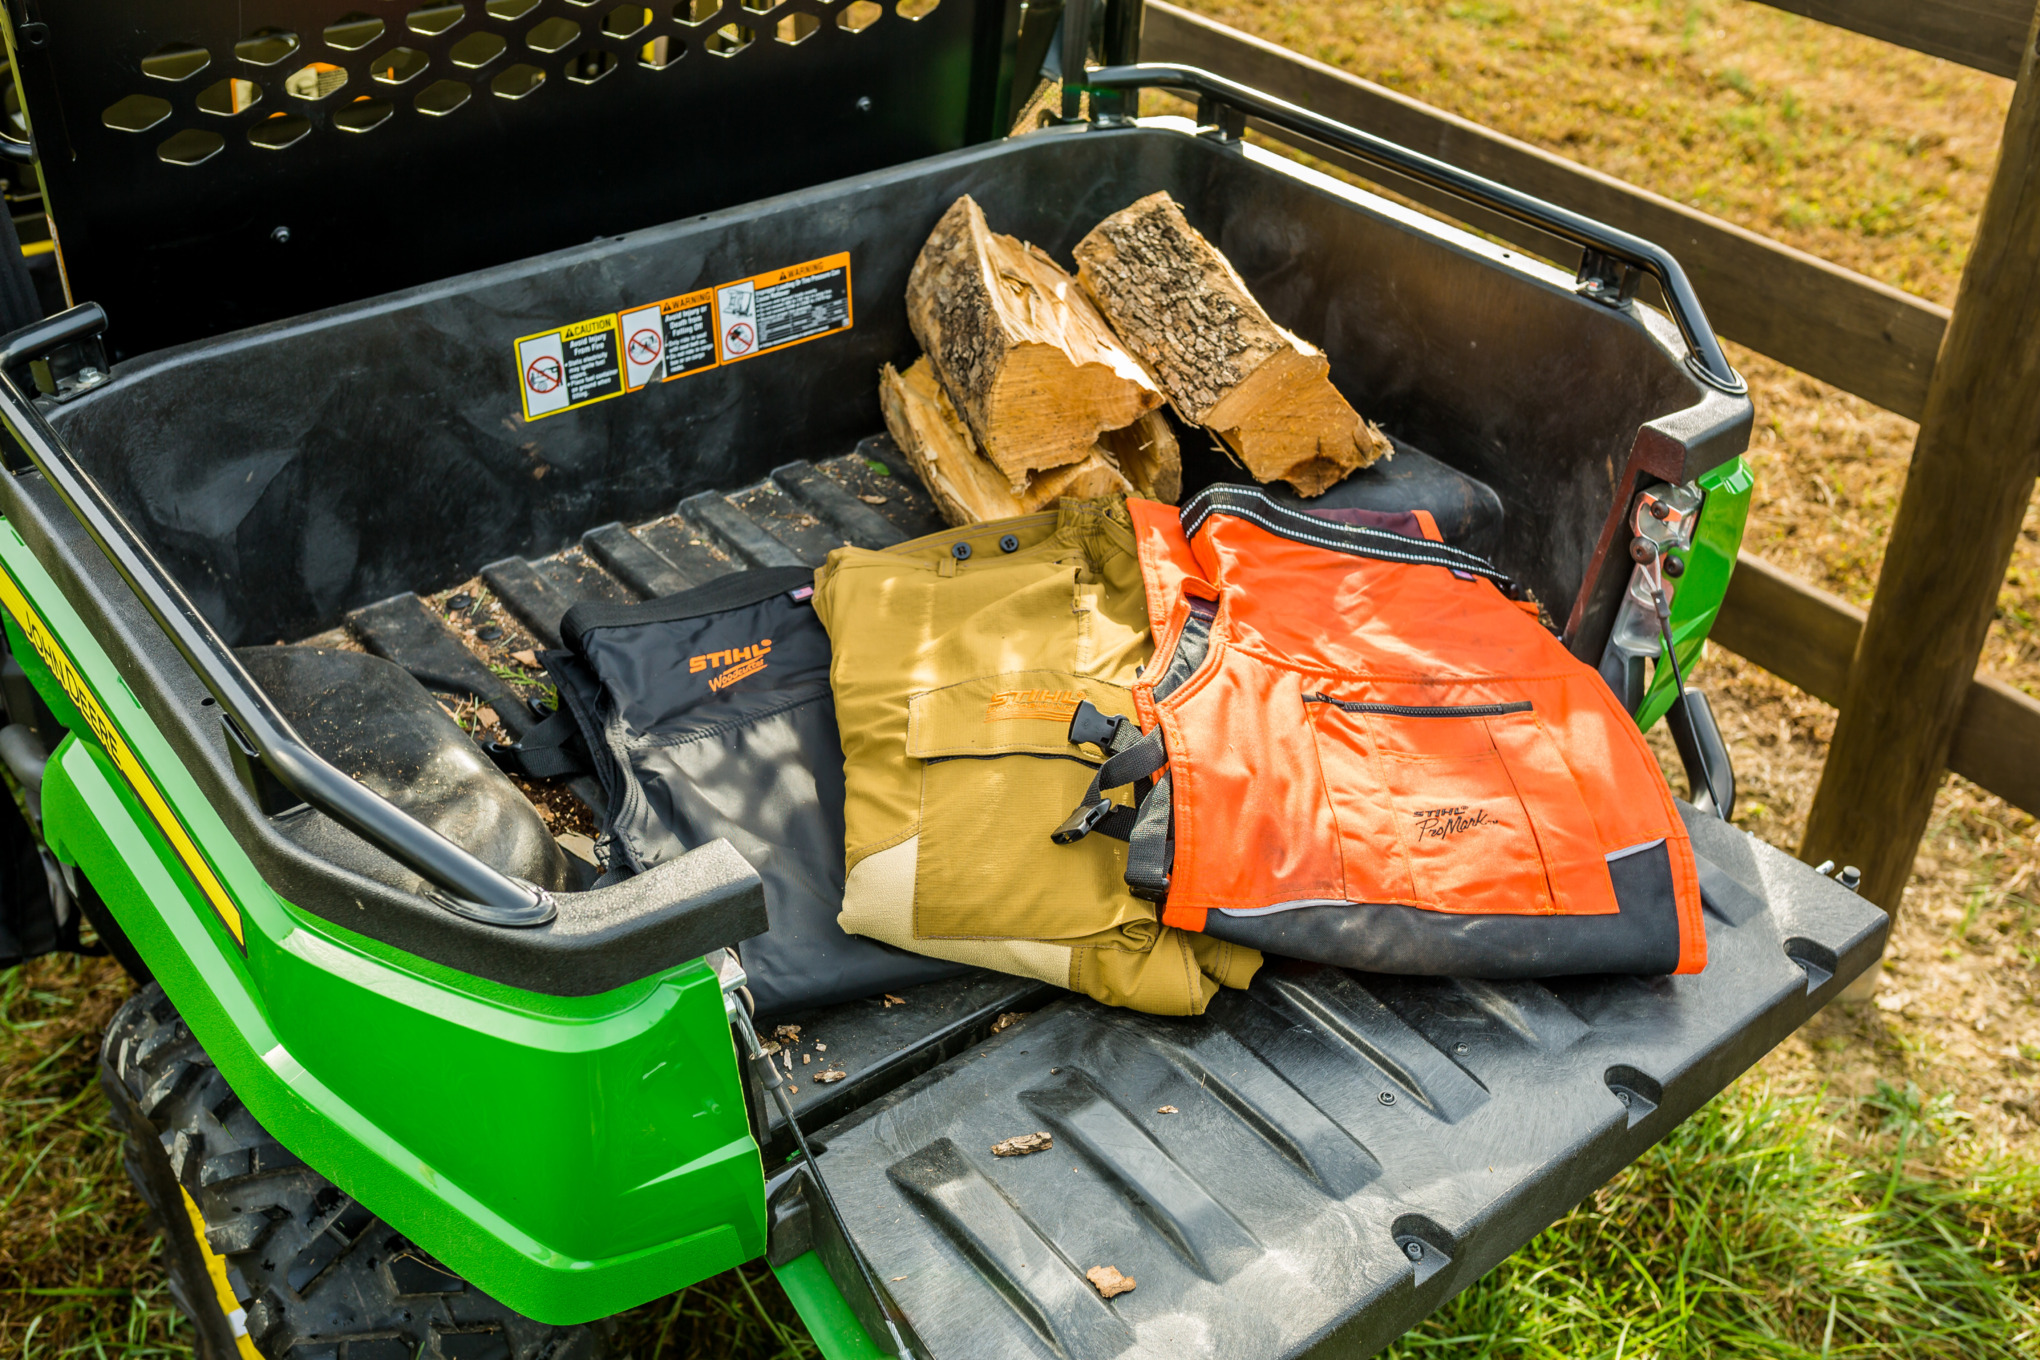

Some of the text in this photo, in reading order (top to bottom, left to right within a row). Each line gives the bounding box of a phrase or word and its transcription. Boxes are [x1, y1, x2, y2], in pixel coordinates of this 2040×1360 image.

[788, 261, 824, 278] WARNING
[671, 291, 711, 310] WARNING
[665, 311, 682, 323] Avoid
[682, 307, 700, 319] Injury
[574, 318, 611, 336] CAUTION
[669, 318, 688, 330] Death
[672, 325, 693, 338] Falling
[569, 333, 607, 349] Avoid Injury
[591, 342, 605, 351] Fire
[689, 640, 772, 674] STIHL
[25, 610, 122, 769] JOHN DEERE
